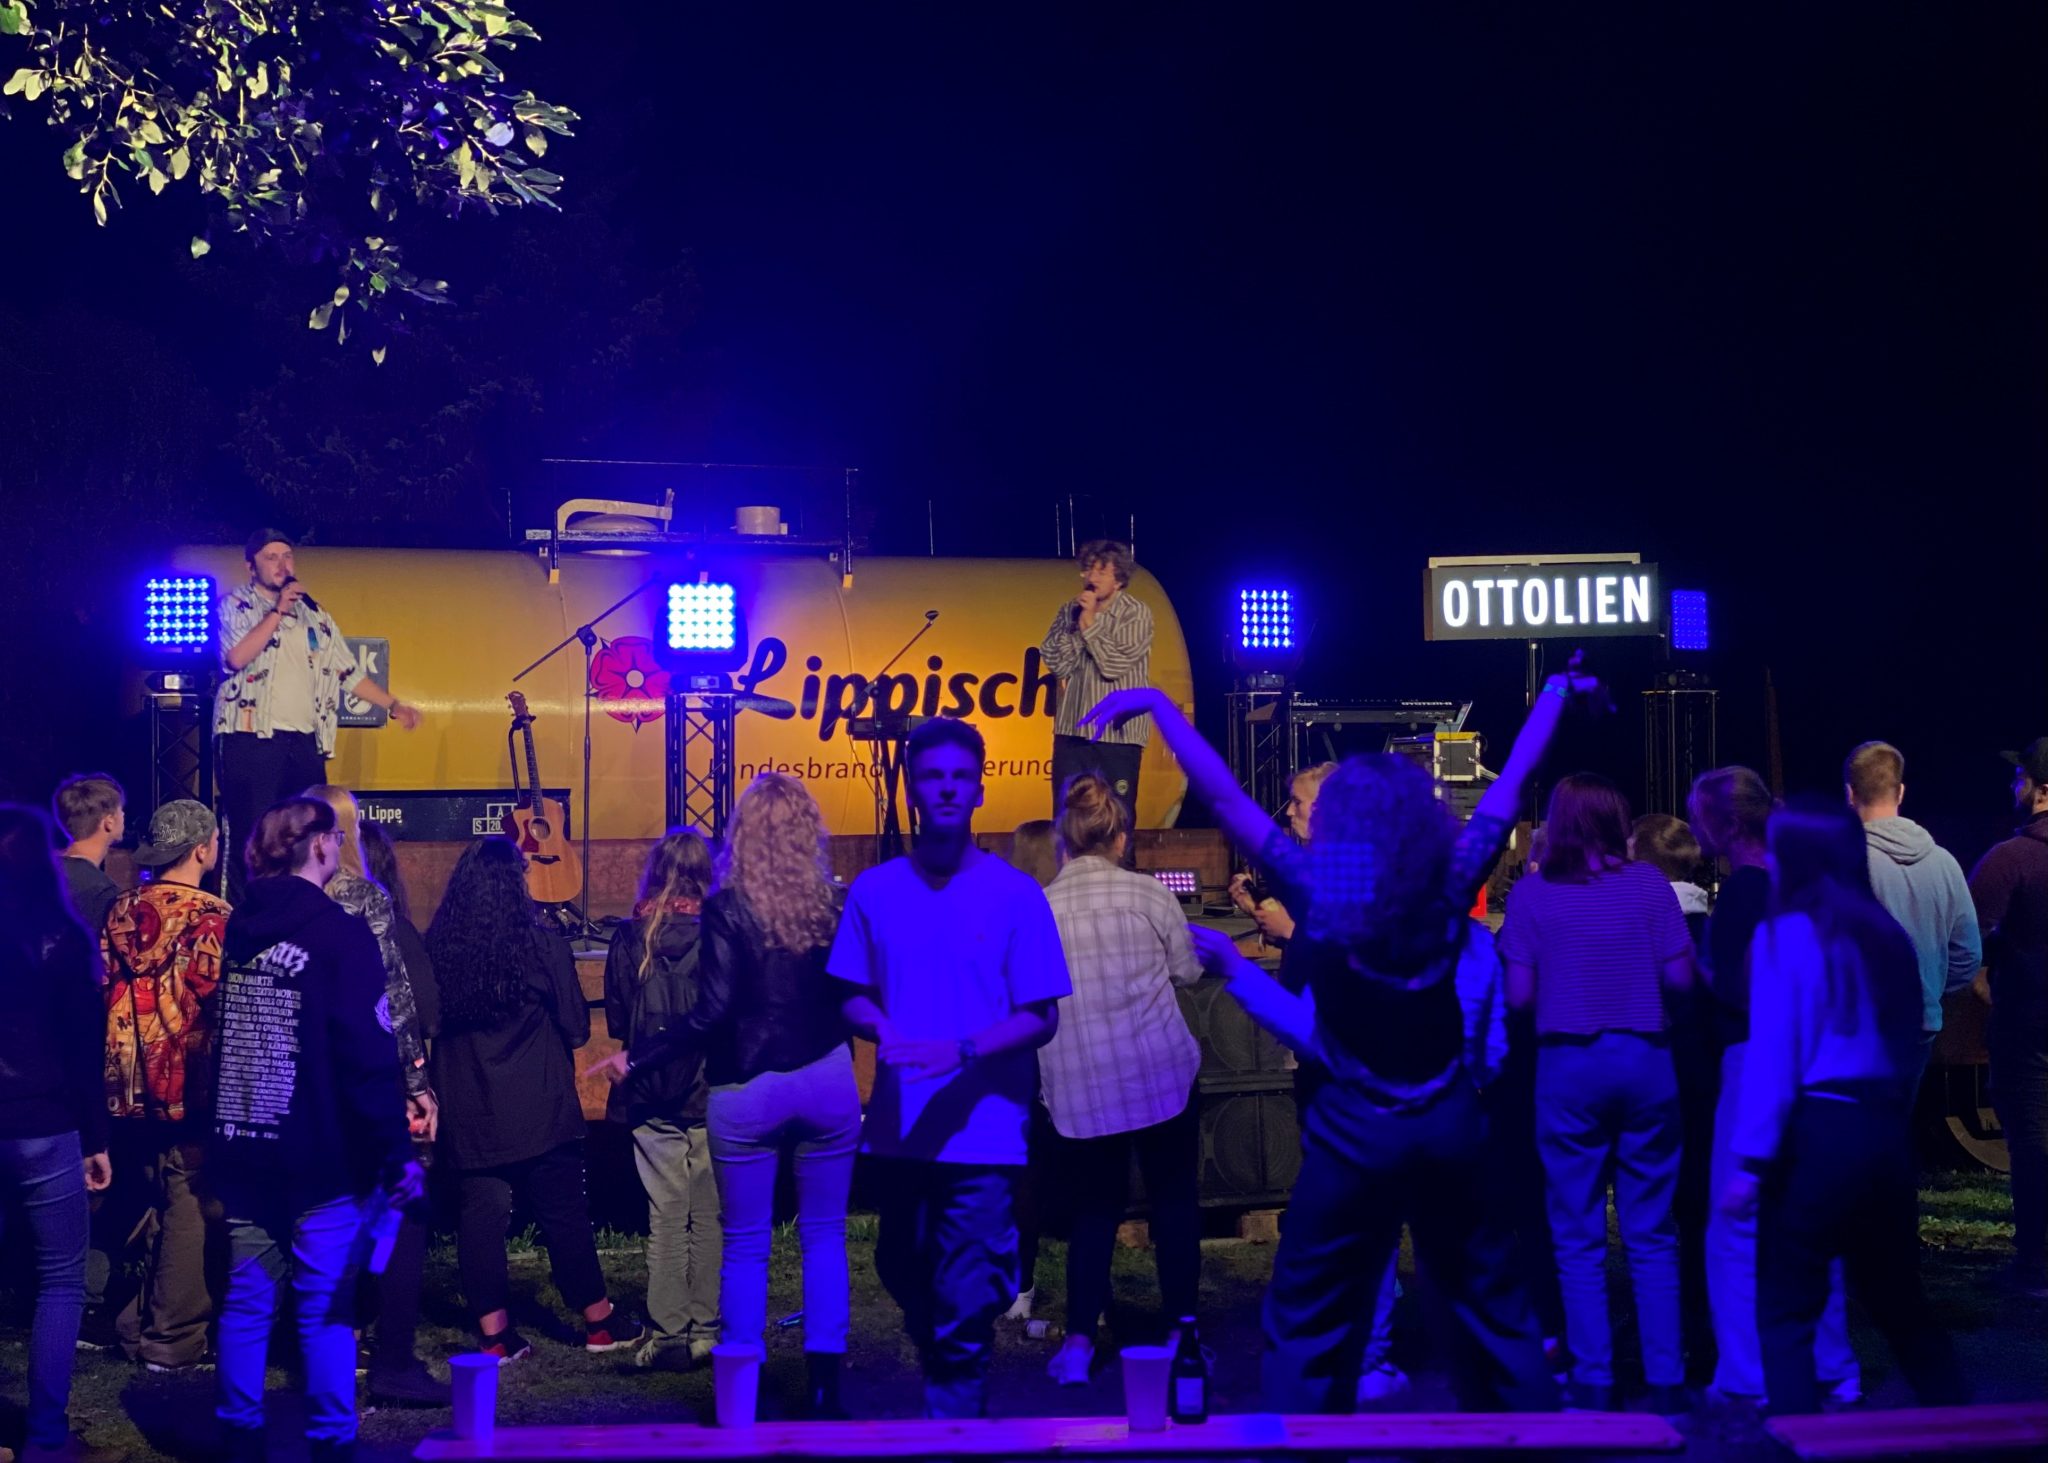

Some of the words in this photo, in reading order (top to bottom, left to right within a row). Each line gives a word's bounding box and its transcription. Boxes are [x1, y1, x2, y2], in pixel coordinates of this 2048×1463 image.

[1442, 575, 1650, 627] OTTOLIEN
[703, 638, 1056, 740] Lippisch
[369, 805, 402, 824] Lippe
[497, 807, 504, 817] A
[475, 820, 482, 832] S
[490, 820, 503, 832] 20.
